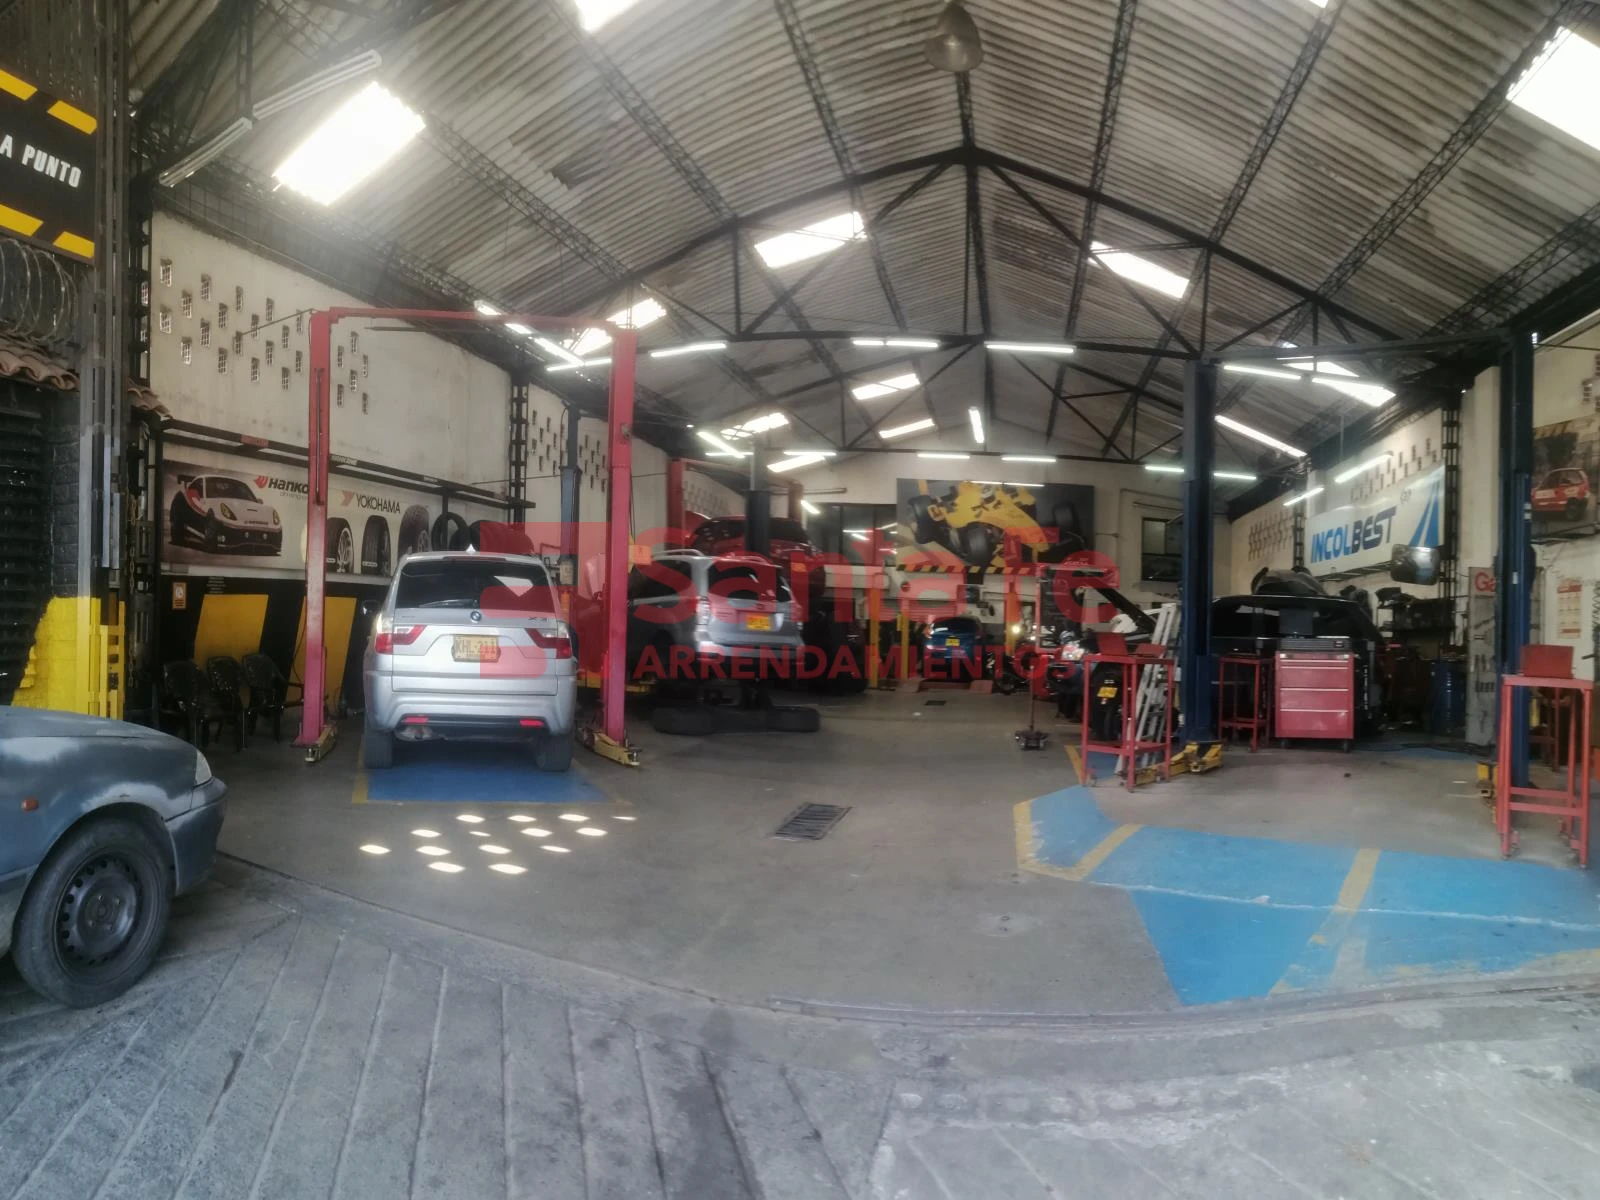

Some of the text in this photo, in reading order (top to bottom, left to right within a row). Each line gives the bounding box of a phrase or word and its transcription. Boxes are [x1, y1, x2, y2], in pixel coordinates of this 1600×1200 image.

[0, 134, 82, 188] A PUNTO
[356, 494, 401, 514] YOKOHAMA
[1311, 505, 1397, 564] INCOLBEST
